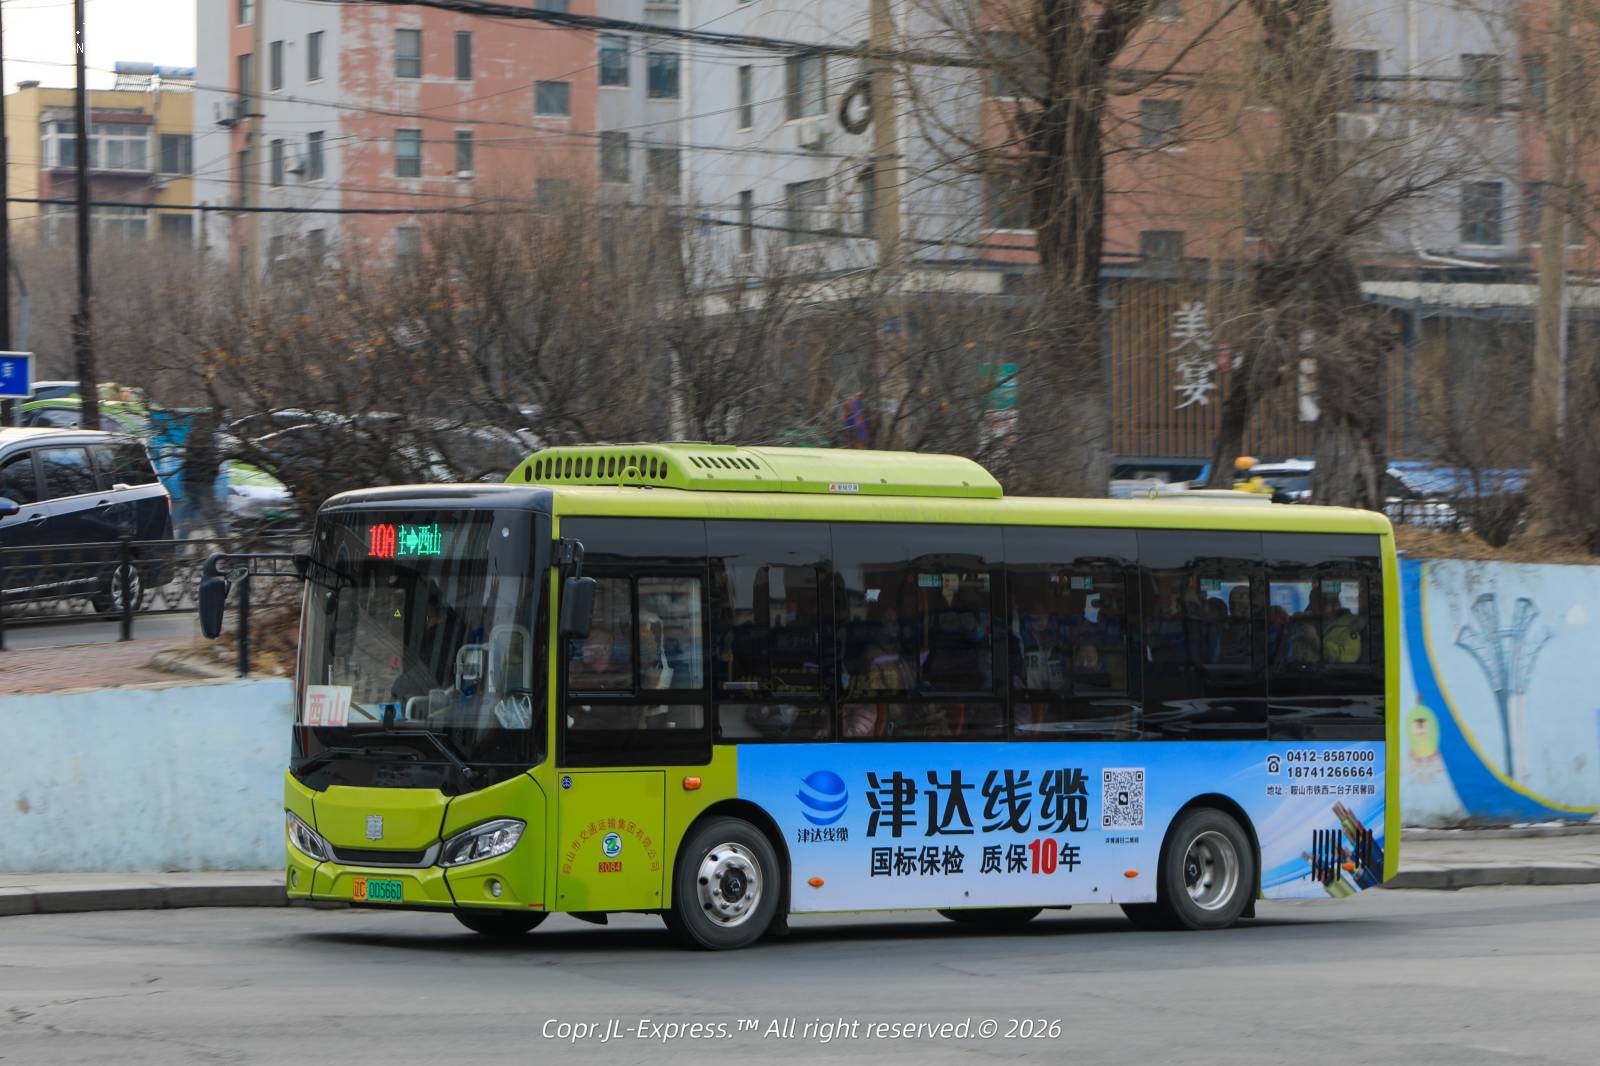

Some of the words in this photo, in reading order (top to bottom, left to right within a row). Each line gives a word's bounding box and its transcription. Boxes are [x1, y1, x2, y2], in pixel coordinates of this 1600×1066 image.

[368, 524, 396, 558] 10A
[308, 692, 346, 726] 西山
[1287, 751, 1375, 762] 0412-8587000
[1287, 766, 1374, 778] 18741266664
[865, 768, 1089, 838] 津达线缆
[796, 828, 849, 844] 津达线缆
[599, 862, 621, 872] 3084
[870, 844, 964, 877] 国标保检
[980, 837, 1082, 875] 质保10年
